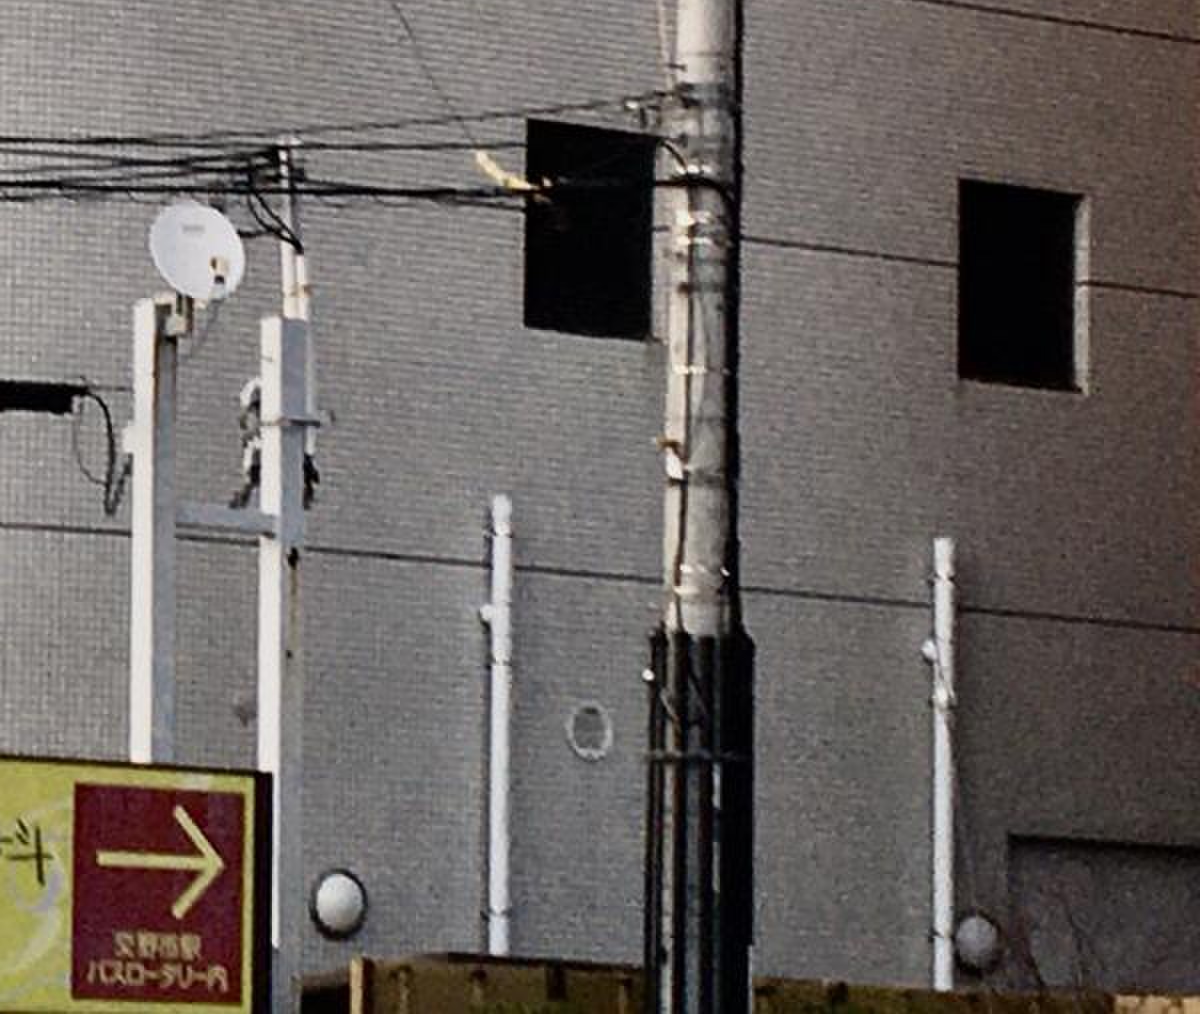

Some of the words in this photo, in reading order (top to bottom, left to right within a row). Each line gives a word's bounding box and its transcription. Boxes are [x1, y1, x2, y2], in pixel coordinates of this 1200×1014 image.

[86, 957, 229, 994] バスロータリー内
